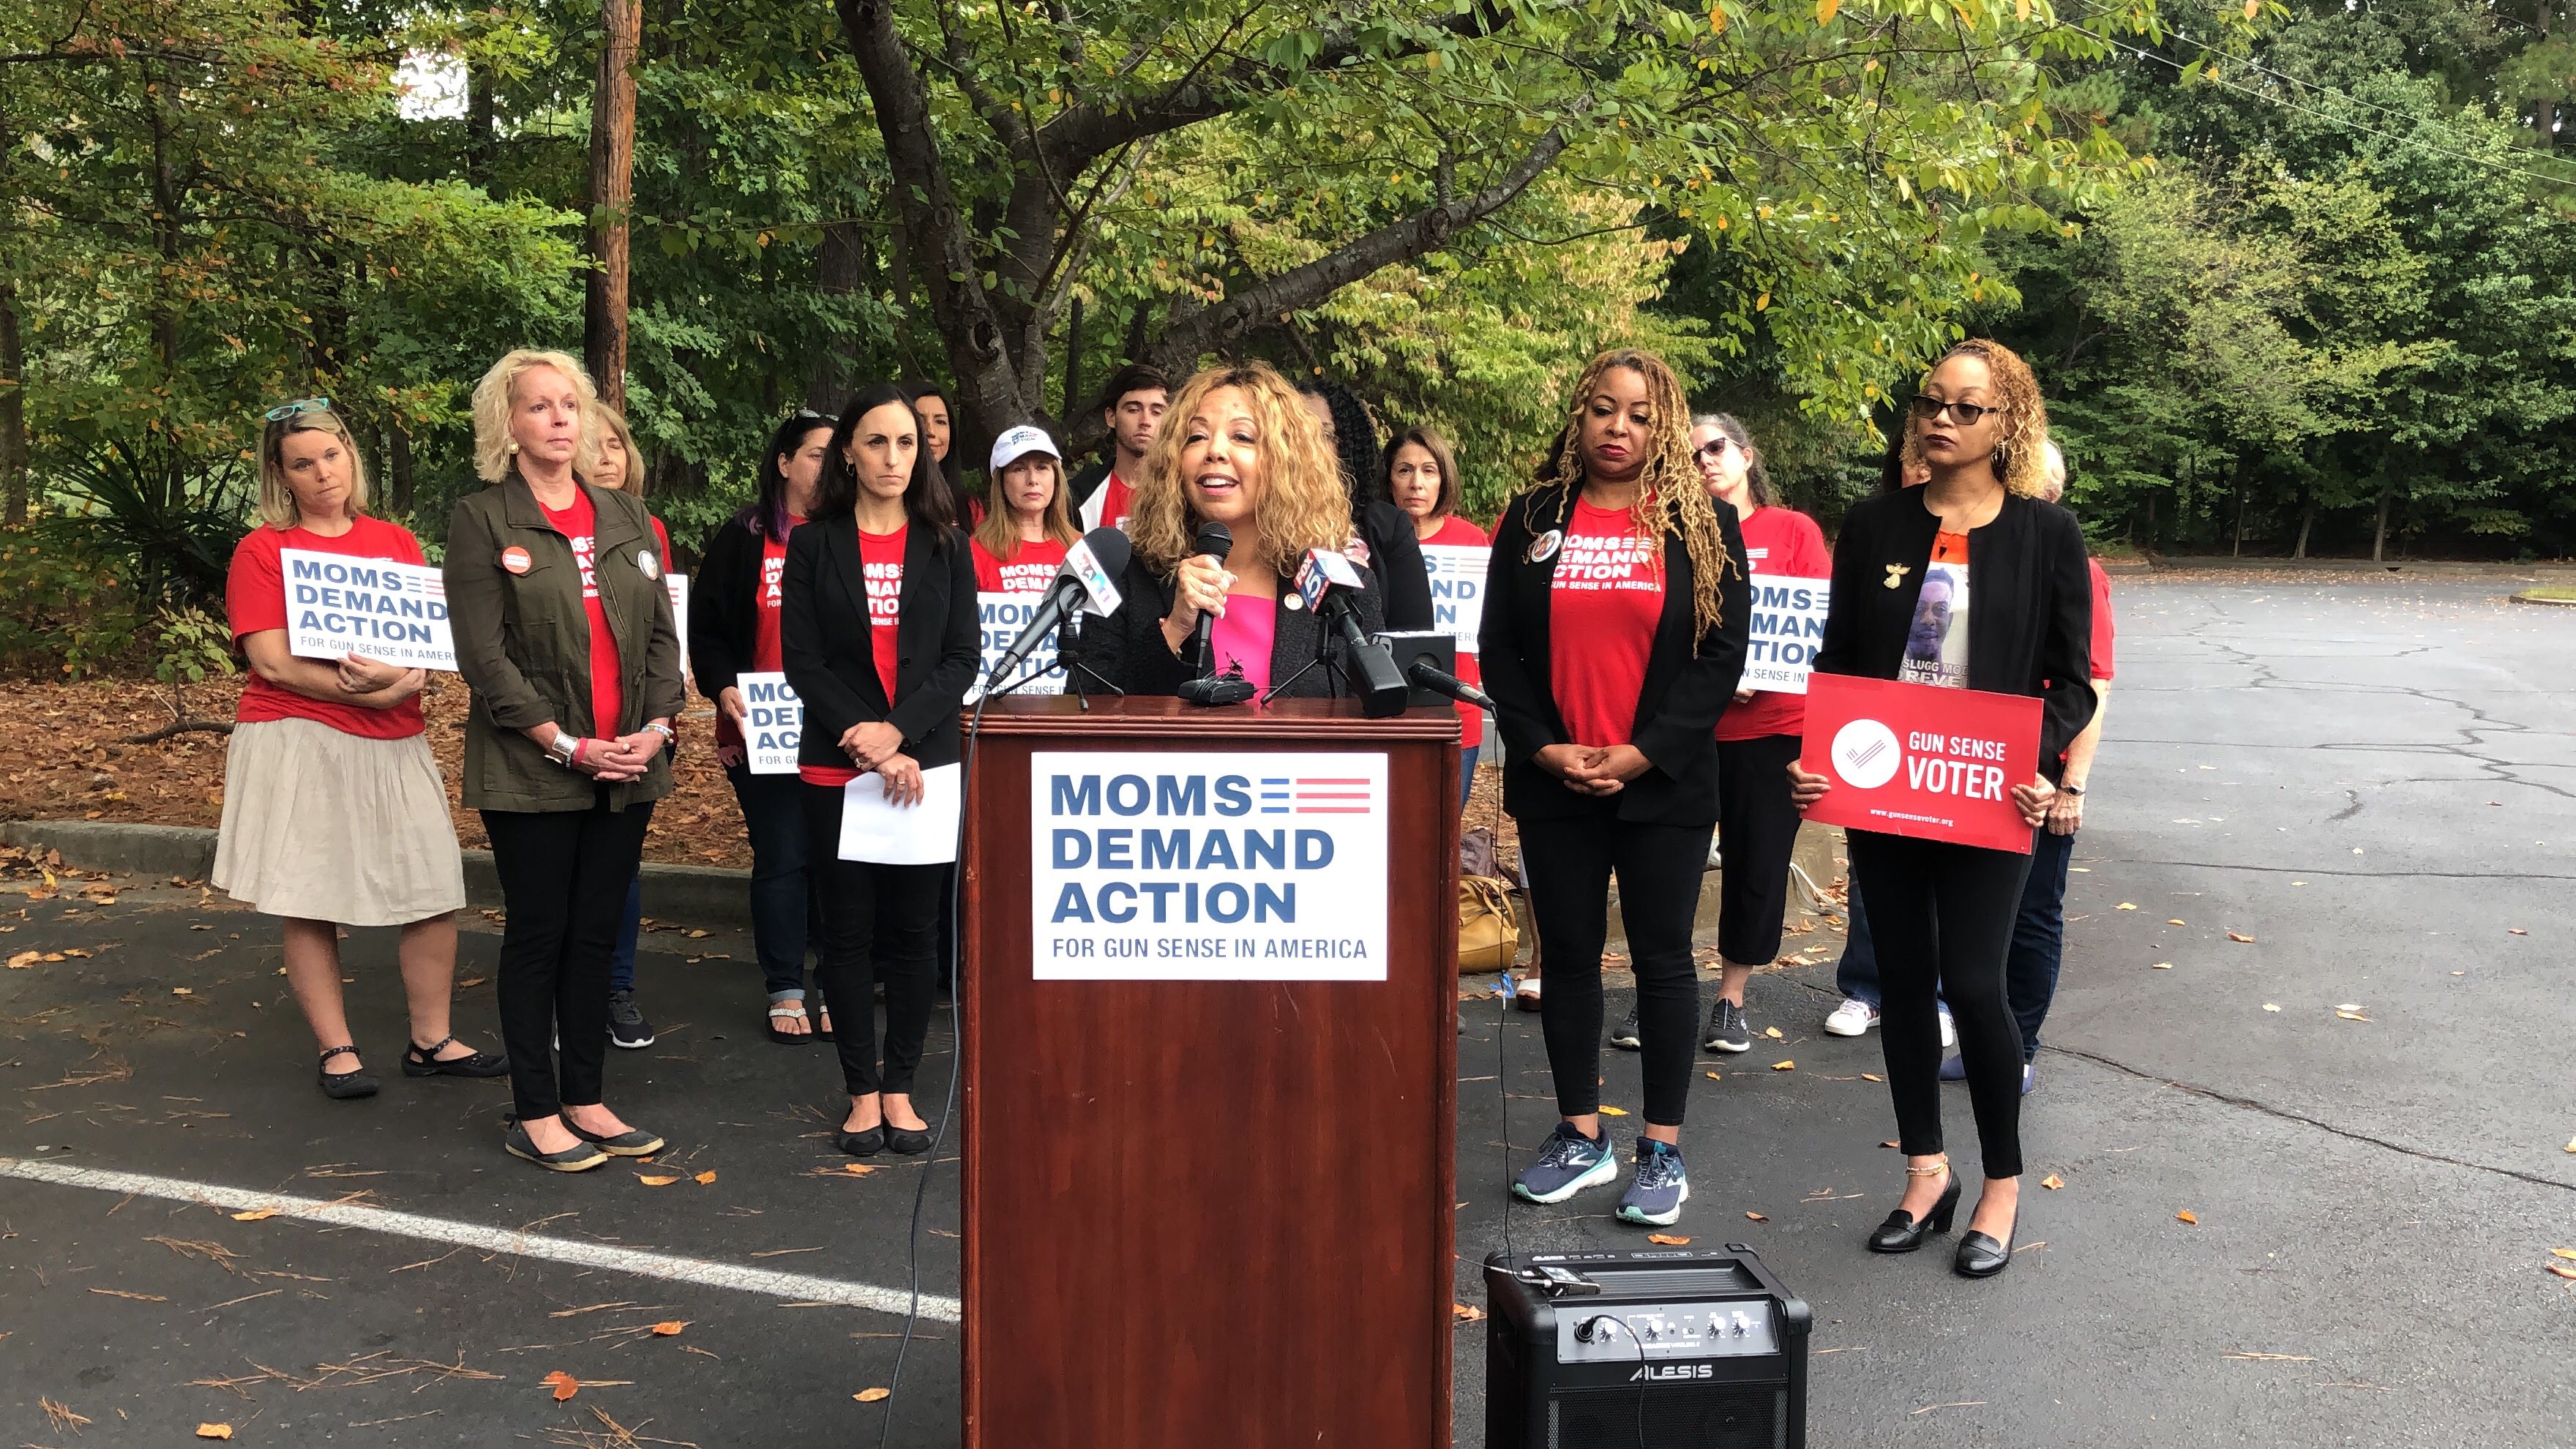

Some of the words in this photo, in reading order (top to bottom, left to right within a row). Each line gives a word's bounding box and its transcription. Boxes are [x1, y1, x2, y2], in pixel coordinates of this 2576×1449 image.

[293, 560, 402, 591] MOMS
[999, 564, 1056, 578] MOMS
[1295, 553, 1314, 586] FOX
[1304, 566, 1322, 599] 5
[1432, 580, 1476, 599] ND
[1569, 581, 1599, 591] SENSE
[1602, 582, 1612, 590] IN
[1614, 581, 1661, 592] AMERICA
[296, 584, 447, 621] DEMAND
[1436, 604, 1456, 624] N
[299, 610, 432, 643] ACTION
[301, 636, 324, 648] FOR
[329, 640, 354, 651] GUN
[359, 643, 397, 656] SENSE
[400, 648, 413, 657] IN
[1754, 668, 1789, 681] SENSE
[1794, 673, 1805, 683] IN
[1903, 659, 1939, 672] SLUGG
[1022, 685, 1055, 695] SENSE
[752, 707, 804, 727] DE
[757, 731, 800, 749] AC
[1909, 730, 1944, 753] GUN
[1949, 736, 2007, 761] SENSE
[759, 755, 782, 765] FOR
[1907, 755, 2004, 801] VOTER
[1051, 774, 1252, 817] MOMS
[1870, 808, 1954, 827] www.gunsensevoter.org
[1052, 828, 1334, 870] DEMAND
[1051, 882, 1295, 924] ACTION
[1052, 938, 1095, 958] FOR
[1104, 938, 1148, 958] GUN
[1157, 938, 1226, 958] SENSE
[1235, 939, 1255, 958] IN
[1264, 939, 1368, 959] AMERICA
[1629, 1364, 1713, 1382] ALESIS
